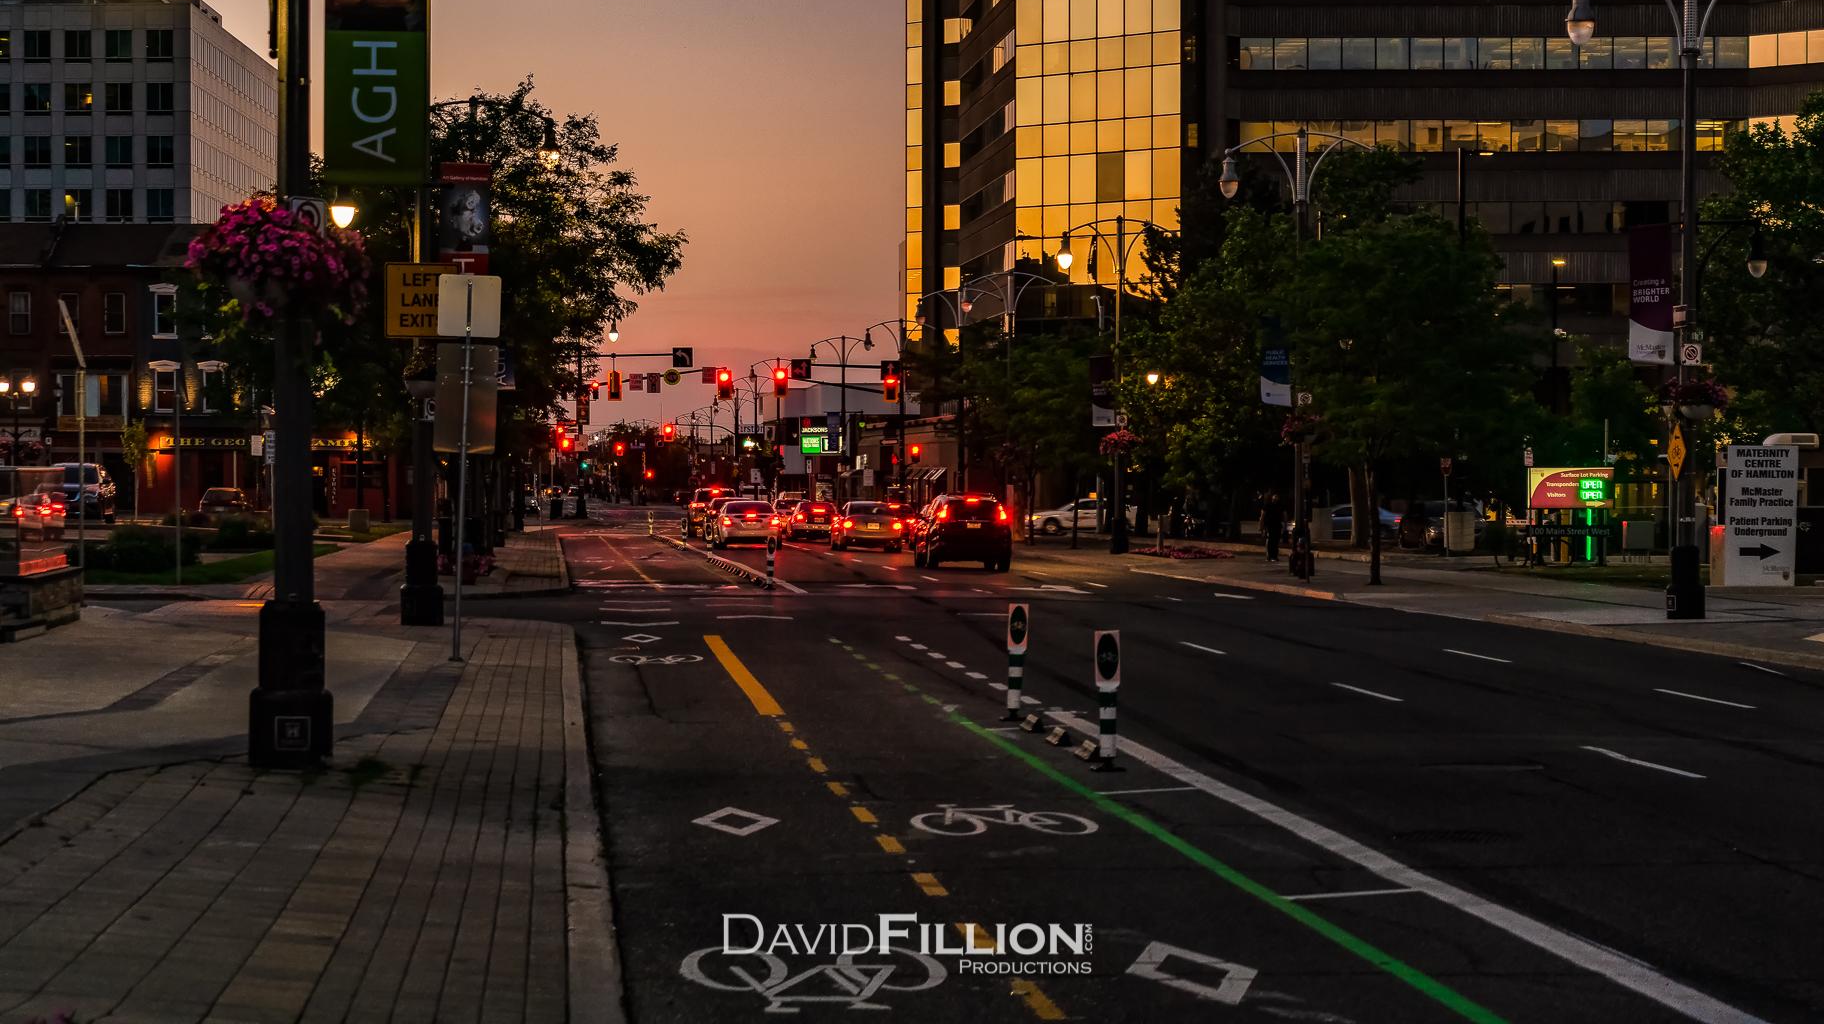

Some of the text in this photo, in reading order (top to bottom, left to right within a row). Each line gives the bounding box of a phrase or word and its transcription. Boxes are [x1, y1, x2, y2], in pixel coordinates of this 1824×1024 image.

[351, 41, 398, 163] AGH
[1632, 287, 1670, 297] BRIGHTER
[1632, 295, 1660, 304] WORLD
[400, 313, 438, 328] EXIT
[1737, 448, 1790, 458] MATERNITY
[1744, 459, 1782, 468] CENTRE
[1731, 469, 1794, 478] OF HAMILTON
[1582, 480, 1603, 489] OPEN
[1582, 491, 1603, 500] OPEN
[1741, 487, 1783, 496] McMaster
[1730, 497, 1794, 508] Family Practice
[1730, 516, 1793, 527] Patient Parking
[1545, 527, 1566, 536] Main
[1567, 527, 1589, 536] Street
[1591, 527, 1611, 536] West
[1734, 527, 1788, 537] Underground
